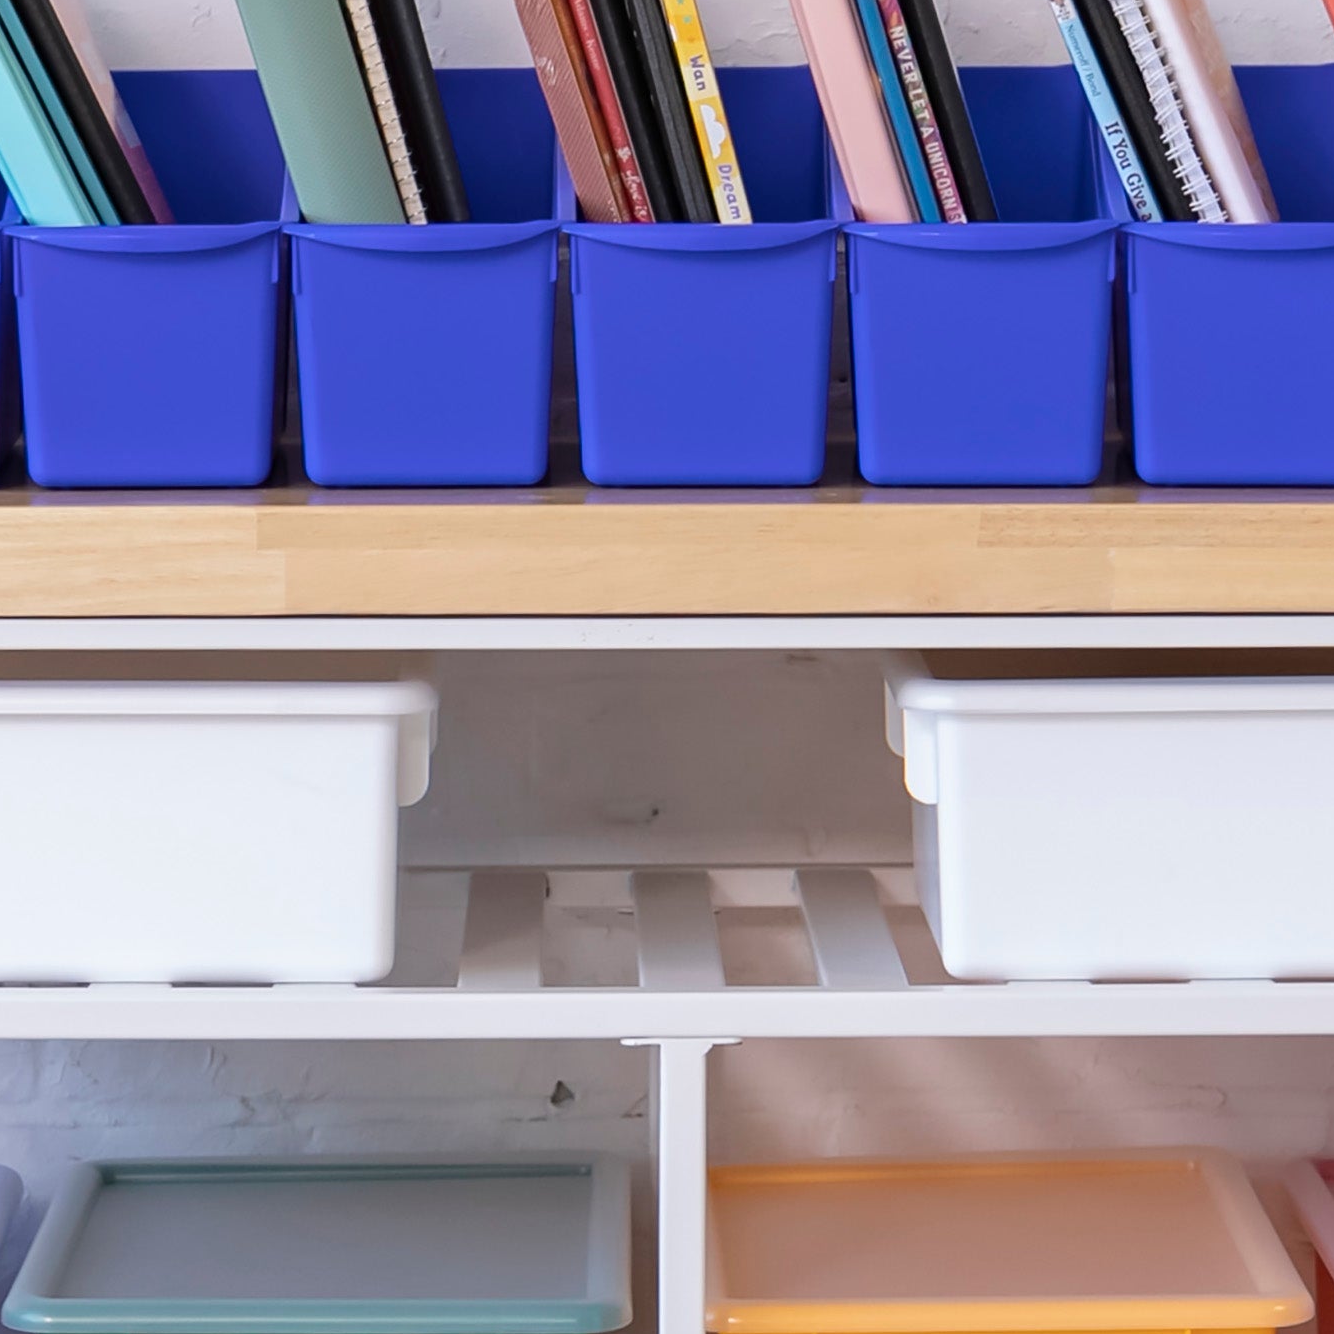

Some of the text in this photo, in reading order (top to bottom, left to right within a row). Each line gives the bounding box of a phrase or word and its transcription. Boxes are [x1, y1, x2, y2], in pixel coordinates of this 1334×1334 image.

[689, 55, 706, 91] Wan
[889, 27, 919, 84] NEVER
[909, 88, 930, 120] LET
[920, 127, 935, 138] A
[1105, 121, 1123, 135] If
[1112, 137, 1132, 170] You
[718, 165, 741, 219] Dream
[925, 142, 957, 209] UNICORN
[1127, 172, 1147, 209] Give
